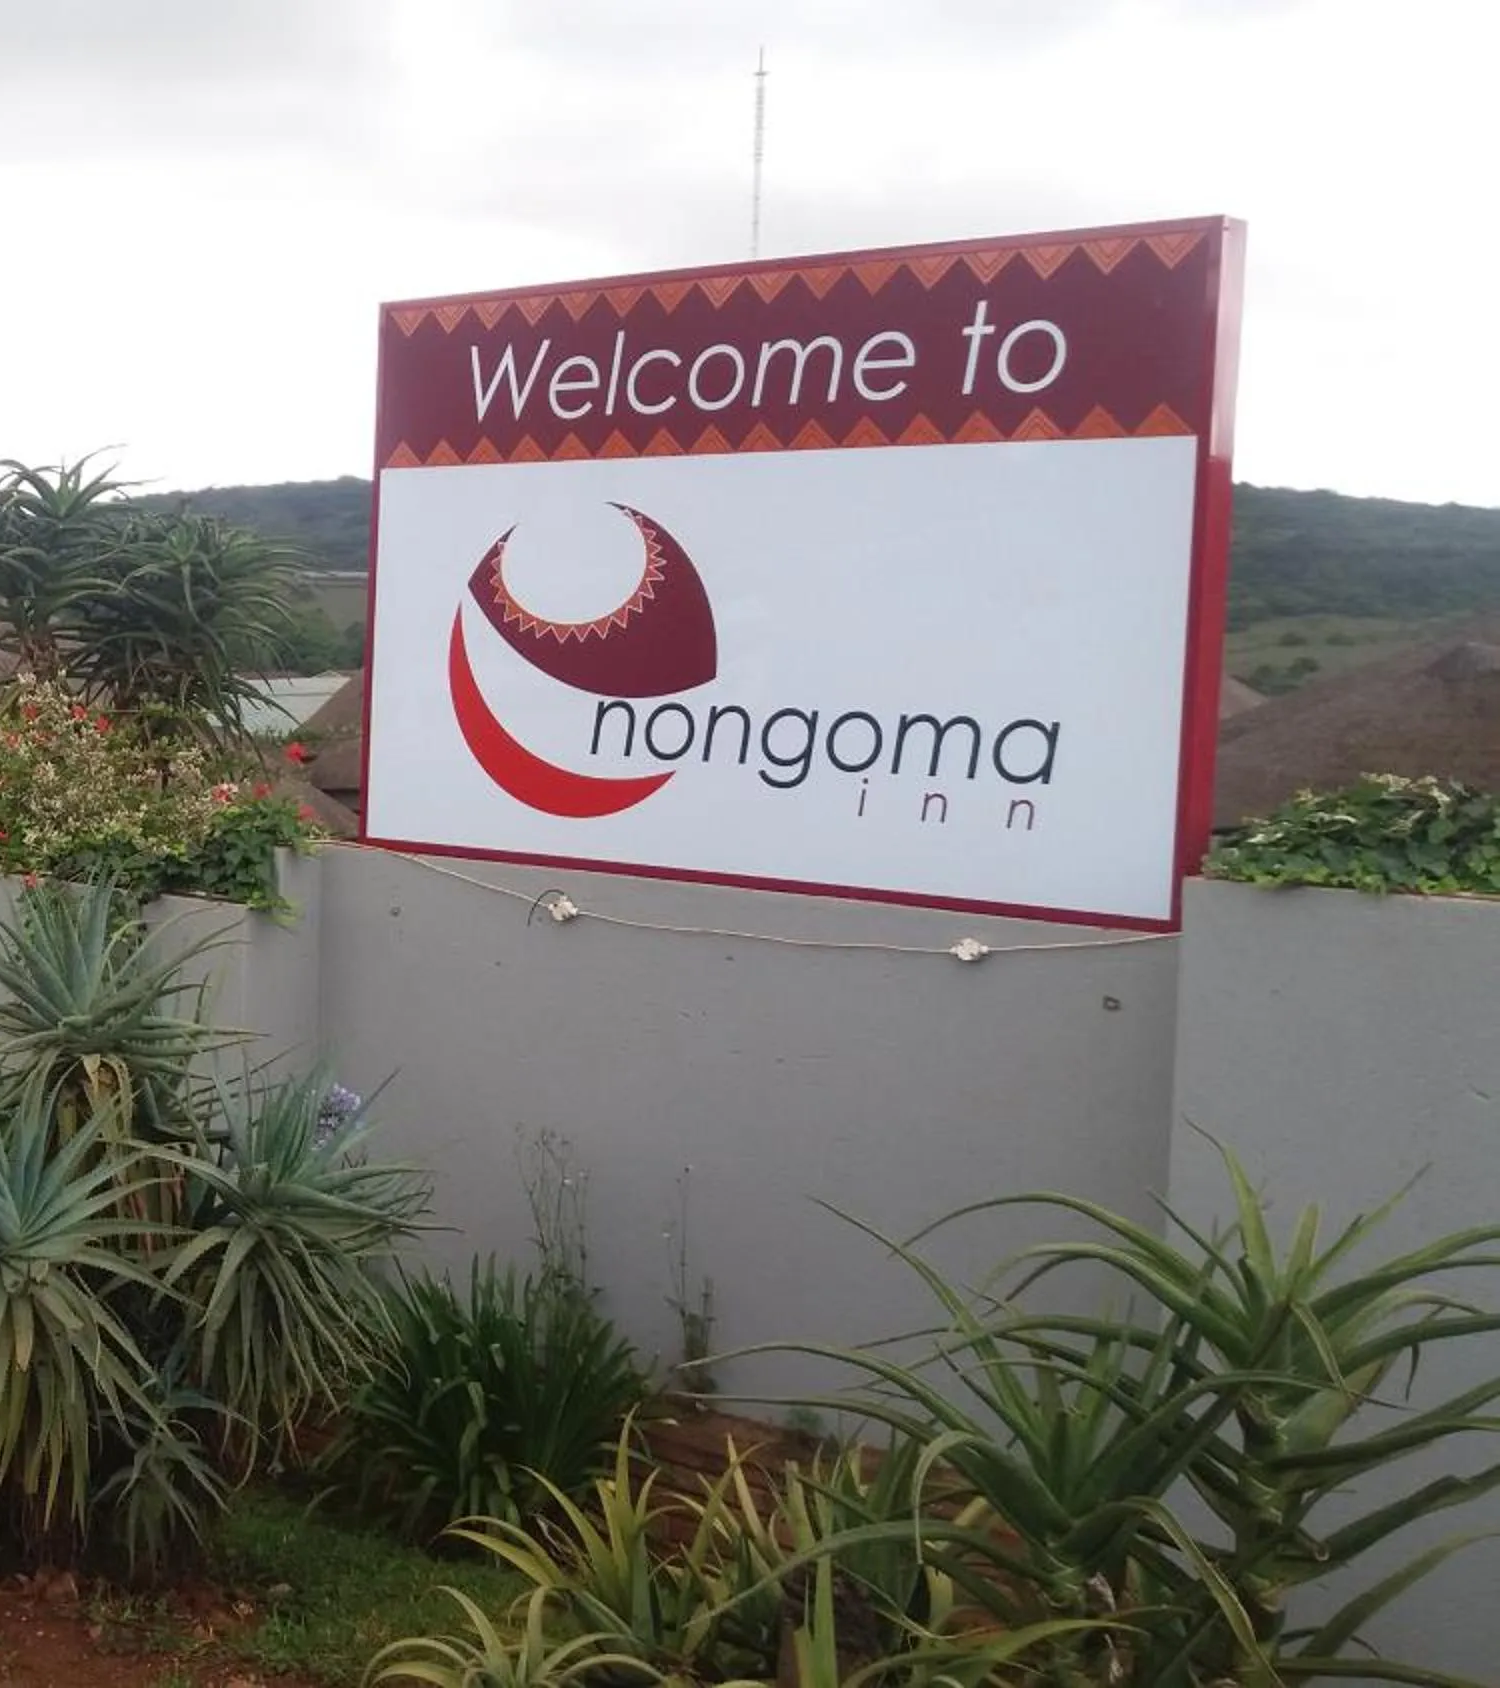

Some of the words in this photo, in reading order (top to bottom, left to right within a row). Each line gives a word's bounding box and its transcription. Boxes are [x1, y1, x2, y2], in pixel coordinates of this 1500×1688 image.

[470, 329, 917, 422] Welcome
[962, 299, 1068, 396] to
[588, 698, 1062, 789] nongoma
